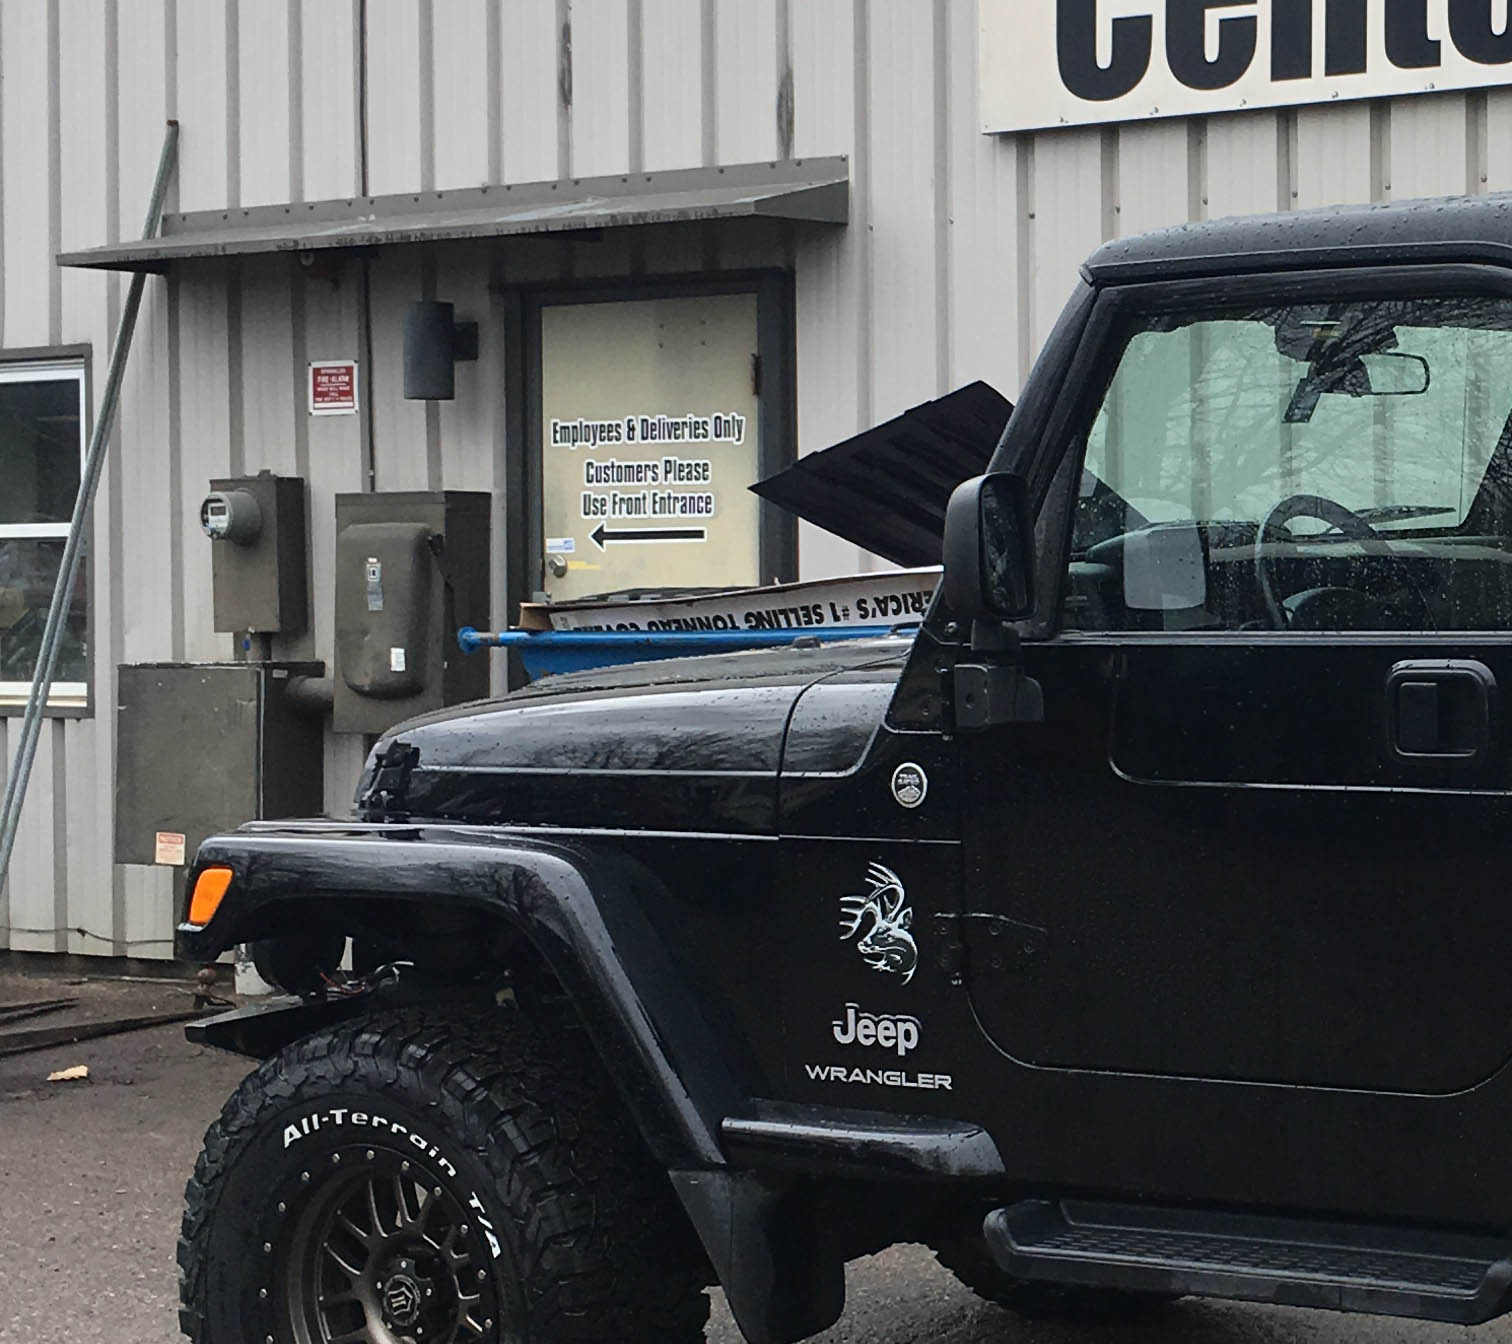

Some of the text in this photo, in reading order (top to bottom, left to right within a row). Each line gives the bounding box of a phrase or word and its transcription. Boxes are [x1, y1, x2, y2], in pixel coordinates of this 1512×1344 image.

[552, 415, 744, 447] Employees & Deliveries Only
[586, 459, 710, 484] Customers Please
[583, 493, 712, 516] Use Front Entrance
[744, 604, 825, 630] SELLING
[829, 602, 850, 623] #1
[832, 1003, 922, 1056] Jeep
[805, 1064, 952, 1090] WRANGLER
[284, 1109, 501, 1258] All-Terrain T/A
